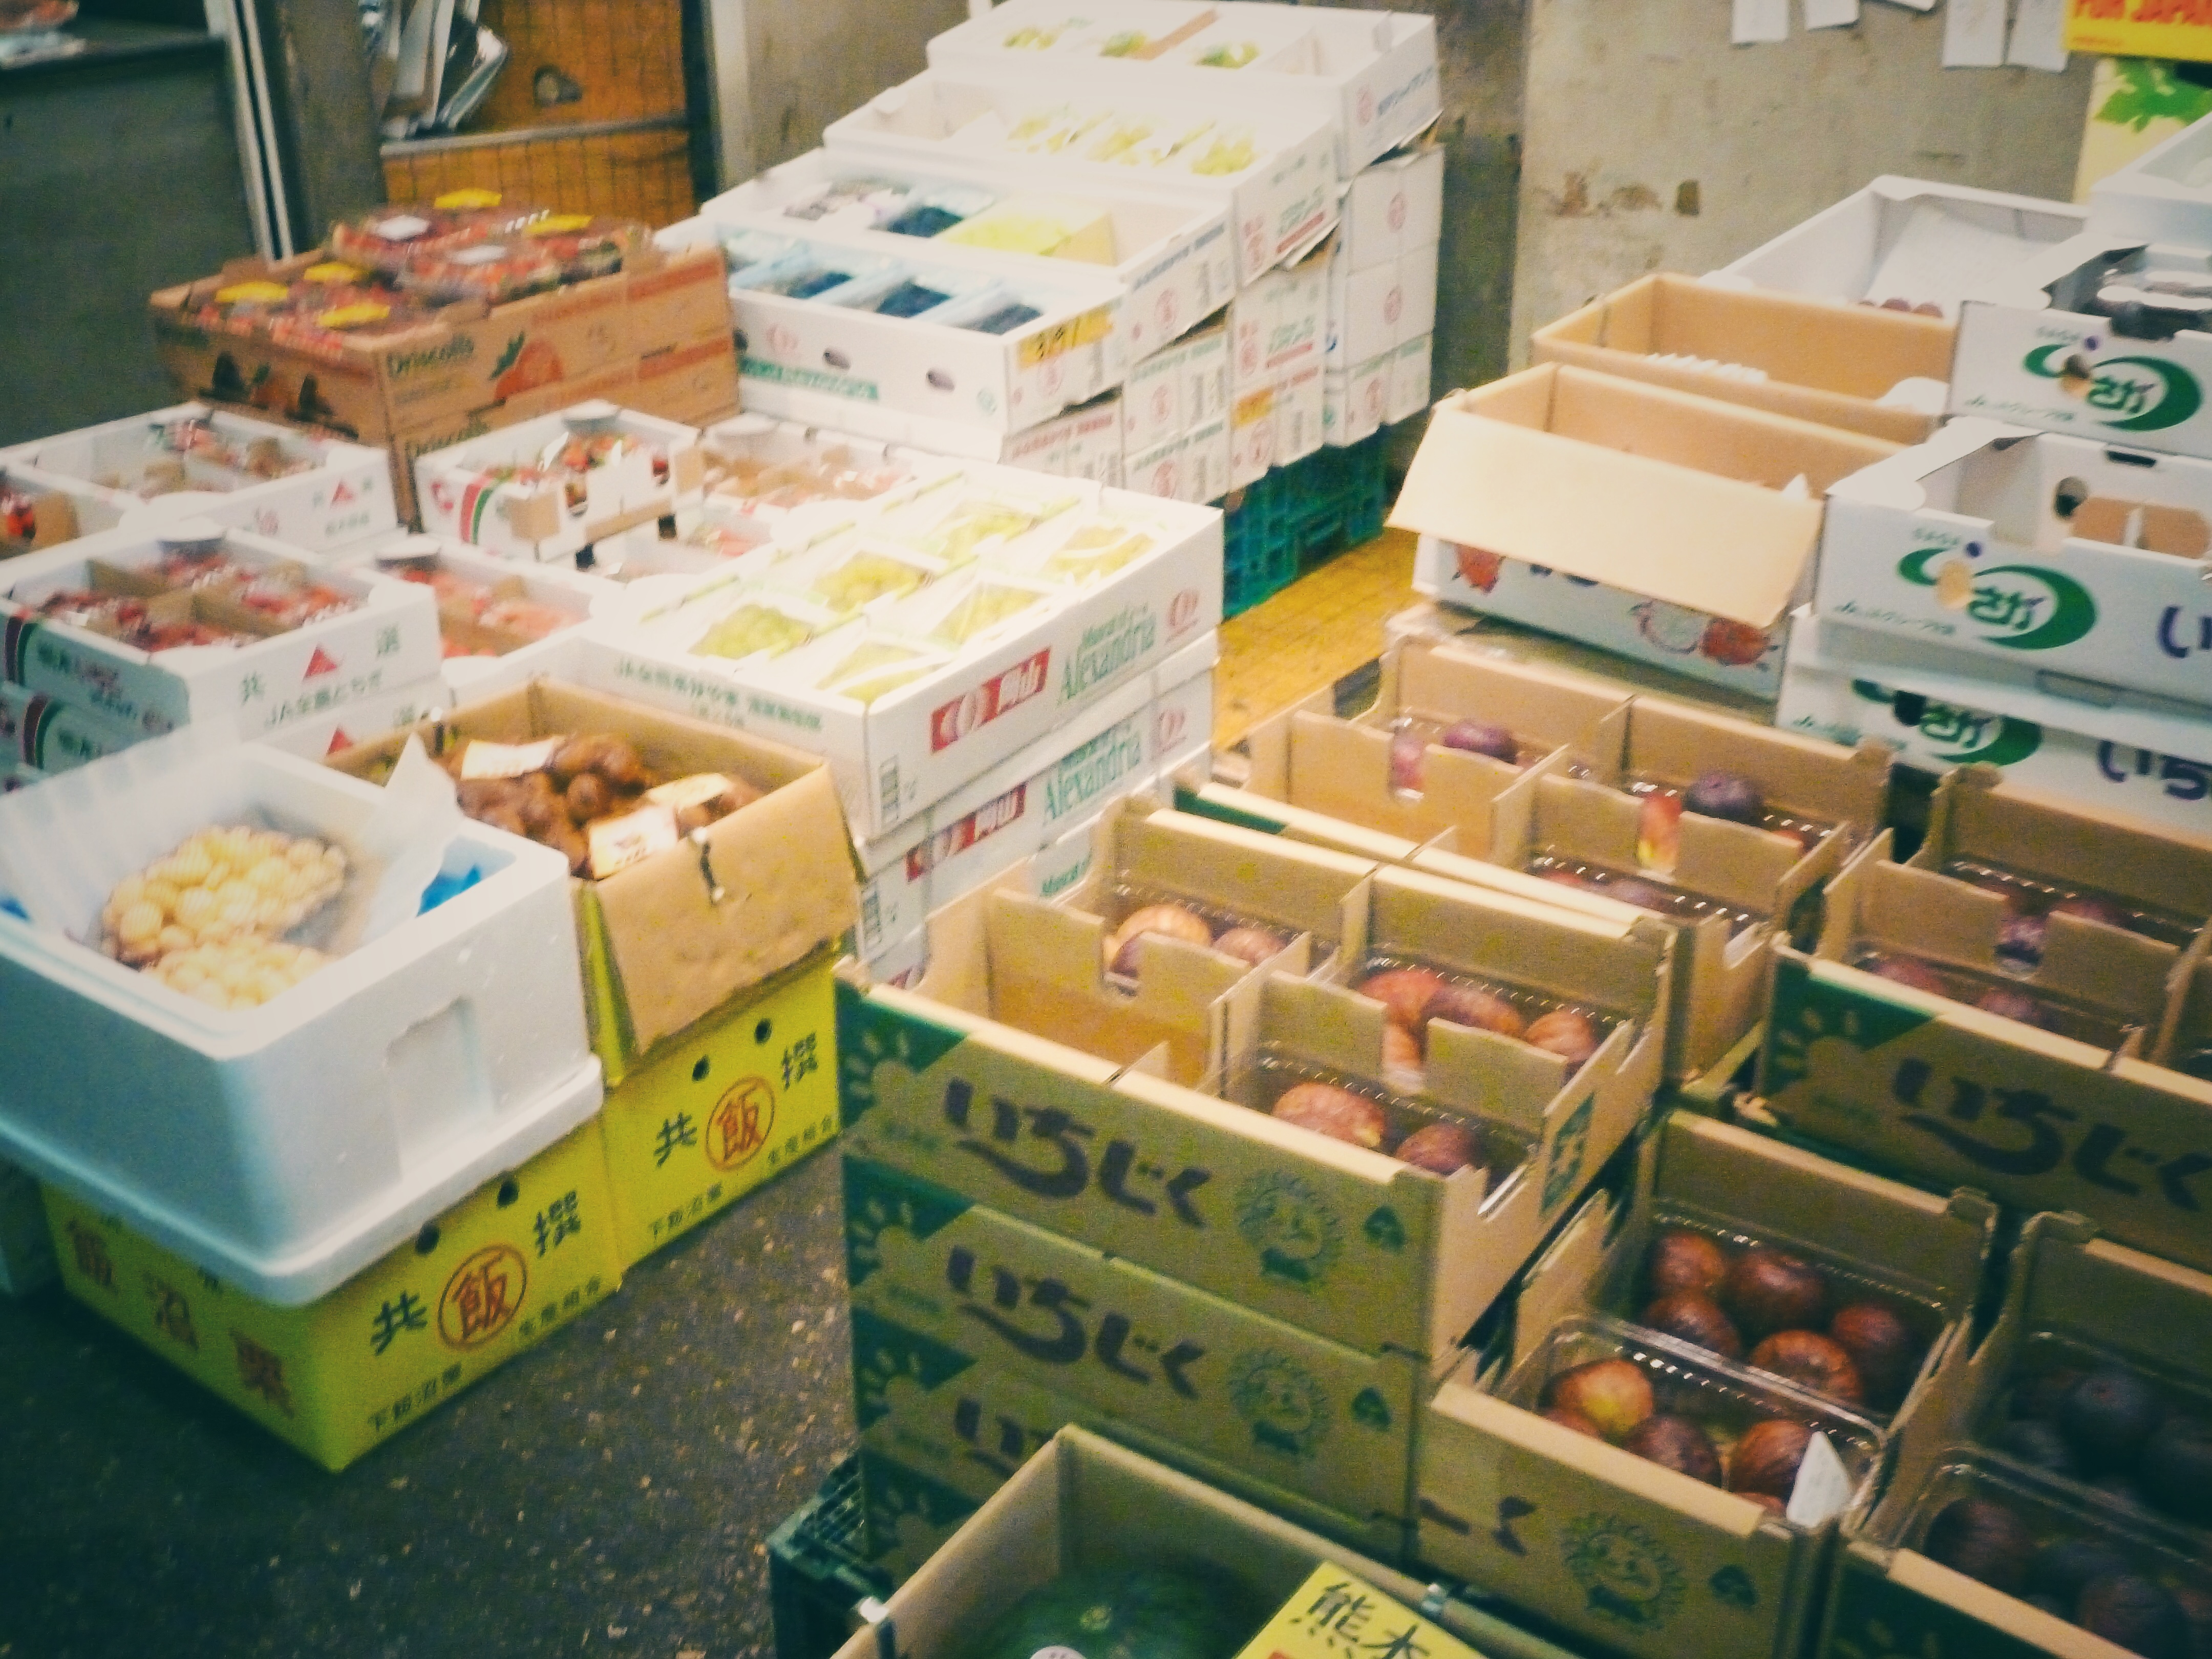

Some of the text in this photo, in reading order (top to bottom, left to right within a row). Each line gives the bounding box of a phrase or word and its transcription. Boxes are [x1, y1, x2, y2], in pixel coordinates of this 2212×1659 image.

[653, 1111, 698, 1168] 共
[943, 1077, 1213, 1229] いちじく
[370, 1289, 428, 1356] 共
[944, 1245, 1208, 1401] いちじく
